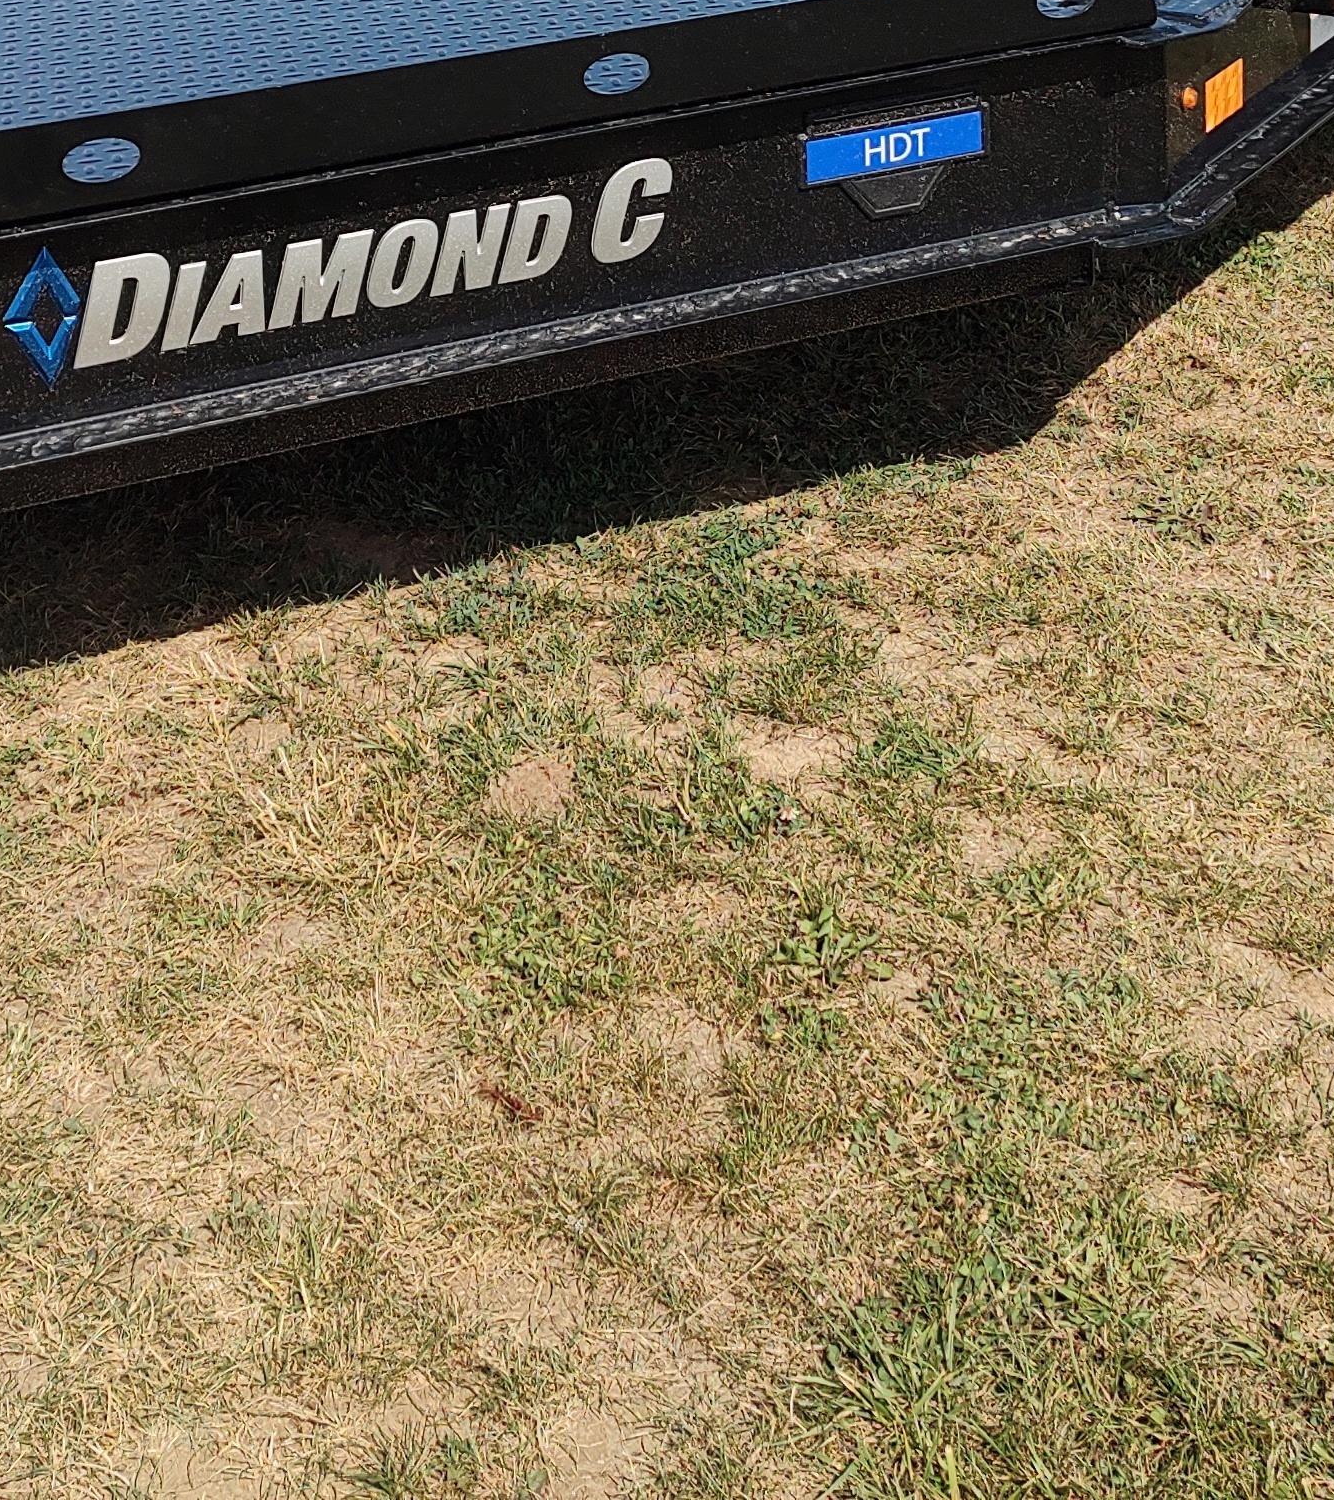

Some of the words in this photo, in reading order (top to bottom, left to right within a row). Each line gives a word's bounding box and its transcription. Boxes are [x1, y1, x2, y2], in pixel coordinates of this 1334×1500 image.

[863, 125, 932, 168] HDT
[73, 193, 573, 371] DIAMOND
[590, 156, 674, 265] C
